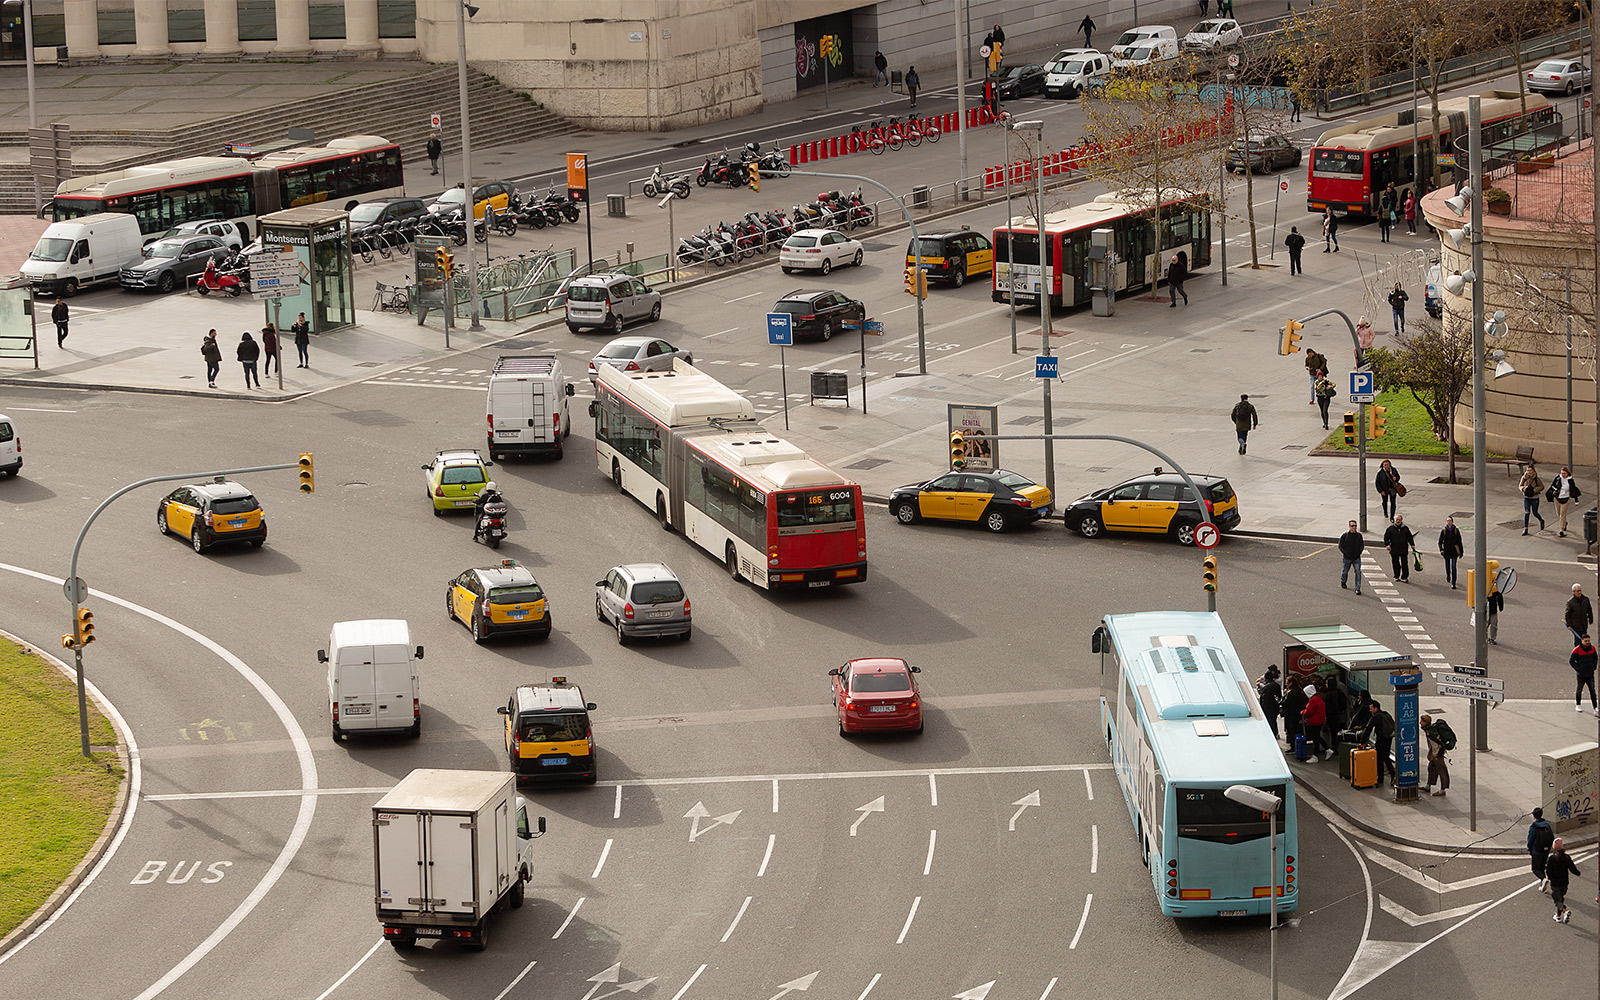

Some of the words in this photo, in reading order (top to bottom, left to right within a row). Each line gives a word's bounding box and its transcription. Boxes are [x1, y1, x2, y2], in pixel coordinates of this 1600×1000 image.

[265, 233, 309, 245] Montserrat
[1036, 363, 1057, 372] TAXI
[1353, 374, 1368, 393] P
[808, 495, 823, 505] 165
[829, 491, 850, 500] 6004
[1300, 655, 1326, 666] nocilla
[1452, 676, 1465, 684] Creu
[1465, 678, 1486, 686] Coberta
[1445, 687, 1464, 695] Estació
[130, 860, 233, 885] BUS
